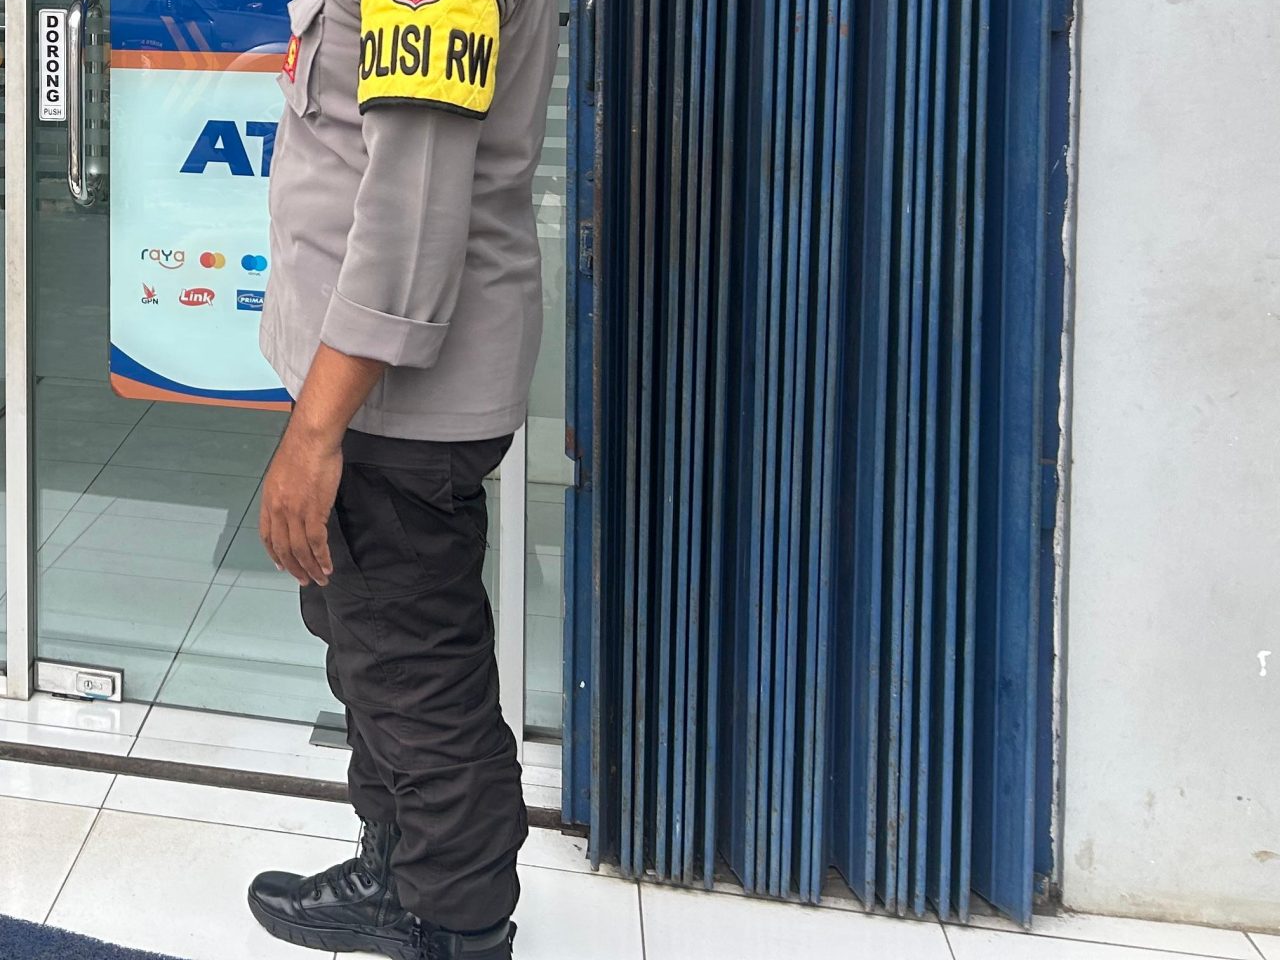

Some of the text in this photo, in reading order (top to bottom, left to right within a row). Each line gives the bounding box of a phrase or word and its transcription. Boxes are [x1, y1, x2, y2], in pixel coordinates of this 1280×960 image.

[46, 15, 60, 103] DORONG
[446, 28, 493, 88] RW
[44, 108, 61, 116] PUSH
[141, 249, 185, 263] raya
[141, 289, 263, 305] GPN Link PRIMA
